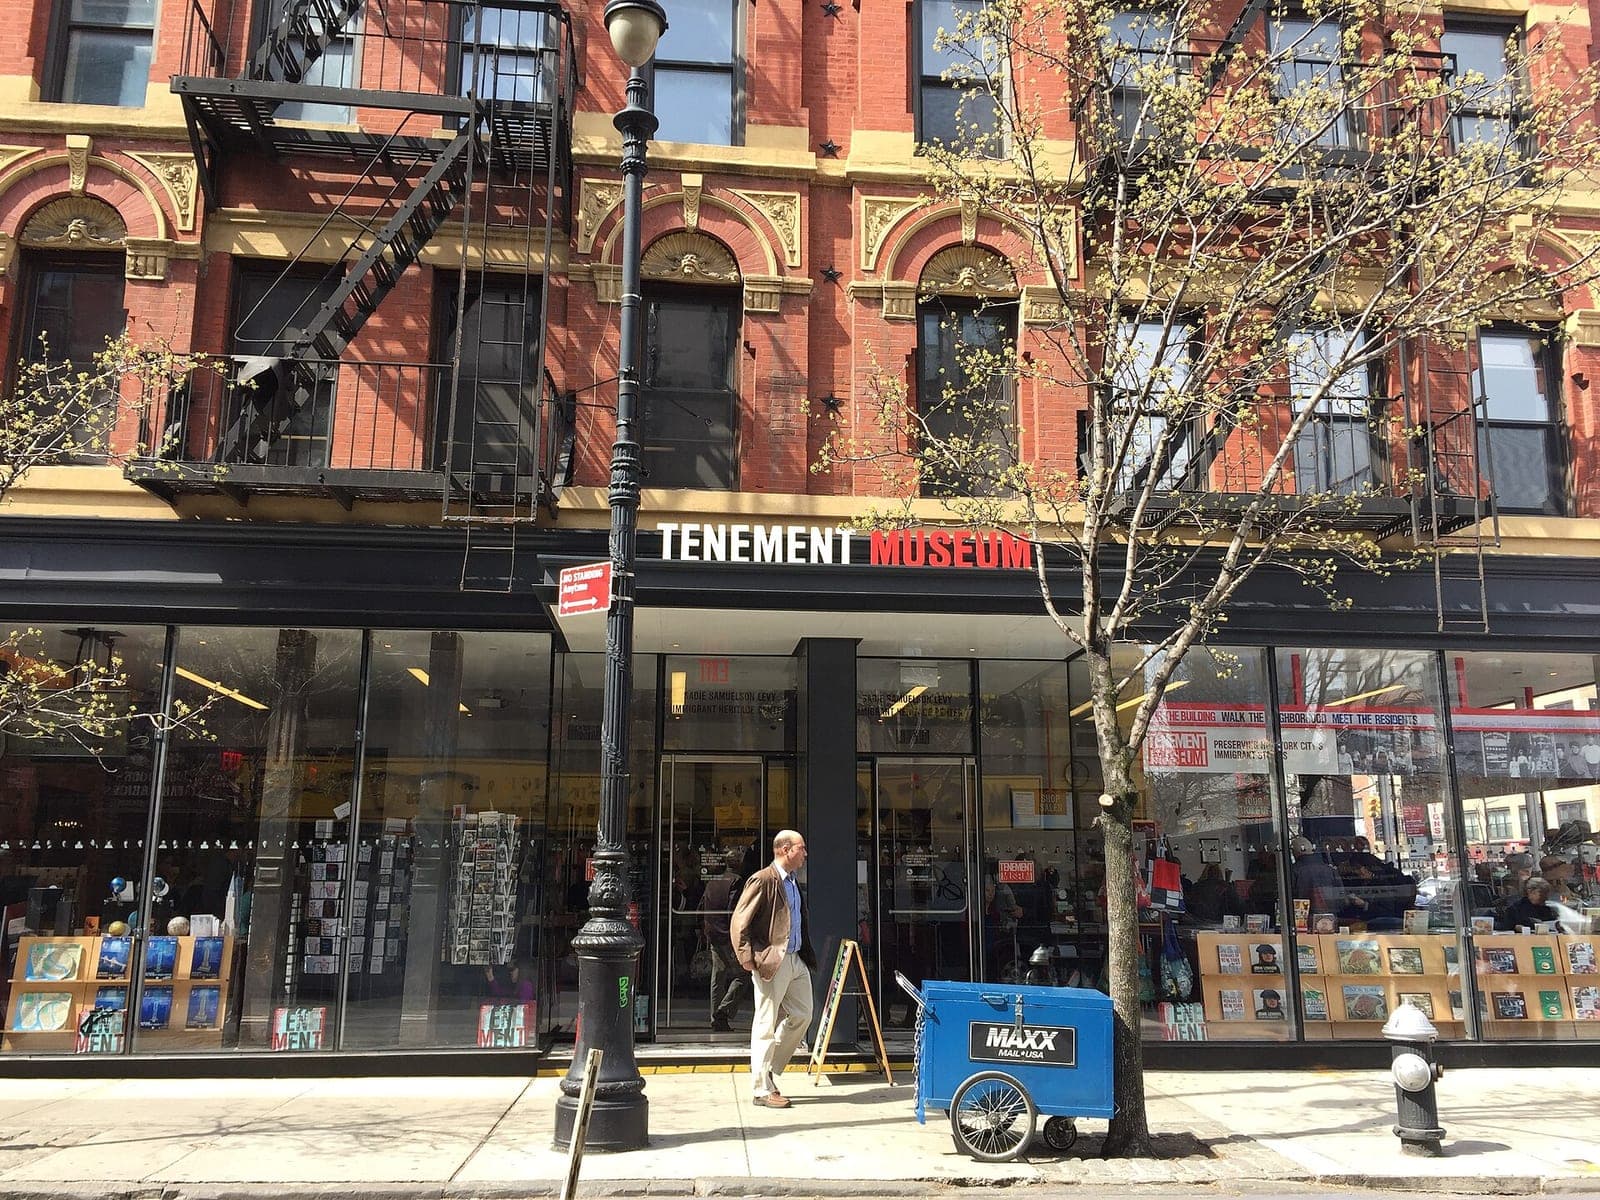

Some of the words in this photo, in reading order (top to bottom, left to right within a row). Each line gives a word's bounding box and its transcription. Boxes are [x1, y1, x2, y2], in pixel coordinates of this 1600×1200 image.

[657, 522, 856, 565] TENEMENT
[870, 529, 1032, 569] MUSEUM
[563, 574, 573, 582] NO
[573, 568, 603, 581] STANDING
[563, 583, 588, 594] Anytime
[709, 691, 754, 701] SAMUELSON
[758, 692, 776, 701] LEVY
[1167, 711, 1180, 721] THE
[1180, 711, 1216, 721] BUILDING
[1221, 711, 1245, 723] WALK
[1249, 712, 1264, 723] THE
[1332, 713, 1353, 724] MEET
[1357, 714, 1372, 725] THE
[1375, 714, 1418, 726] RESIDENTS
[1149, 734, 1206, 749] TEMENT
[1283, 741, 1298, 751] ORK
[1150, 750, 1207, 766] SEUM
[272, 1031, 322, 1050] MENT
[985, 1027, 1059, 1051] MAXX
[998, 1048, 1020, 1057] MAIL
[1025, 1050, 1044, 1059] USA
